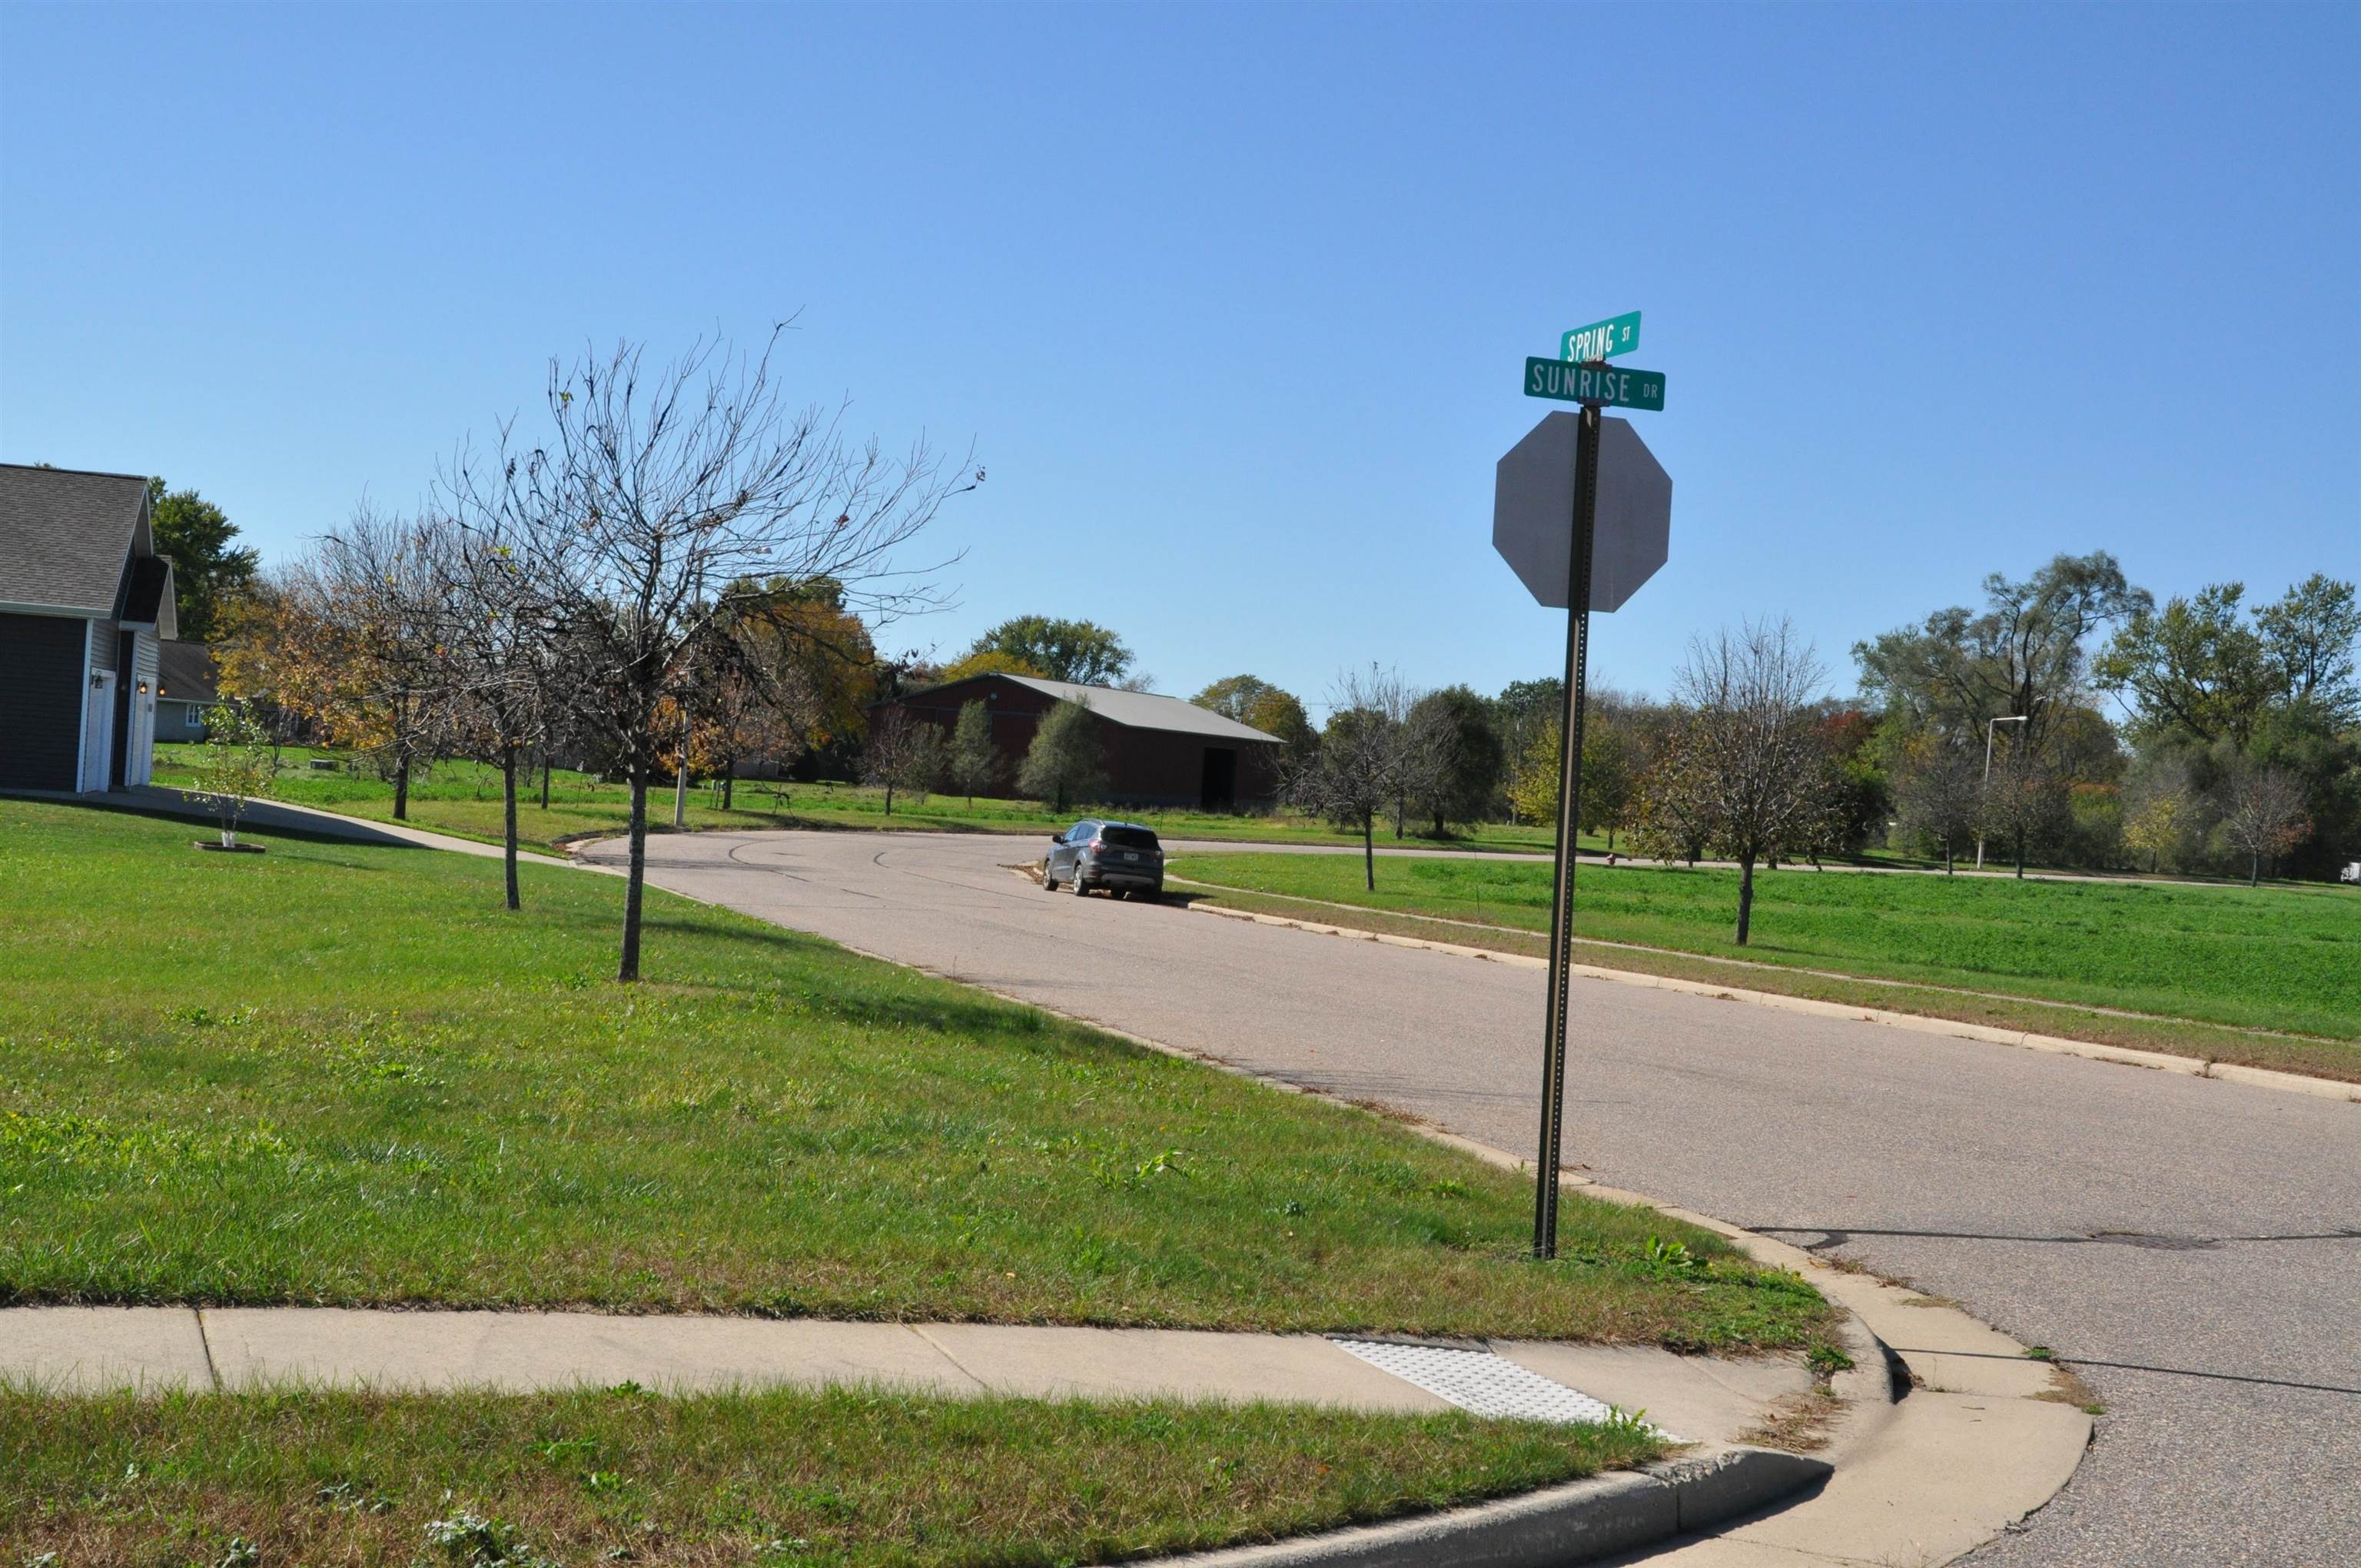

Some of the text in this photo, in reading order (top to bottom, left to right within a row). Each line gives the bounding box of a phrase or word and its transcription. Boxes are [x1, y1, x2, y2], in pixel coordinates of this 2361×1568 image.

[1567, 324, 1631, 362] SPRING ST
[1532, 364, 1658, 402] SUNRISE DR
